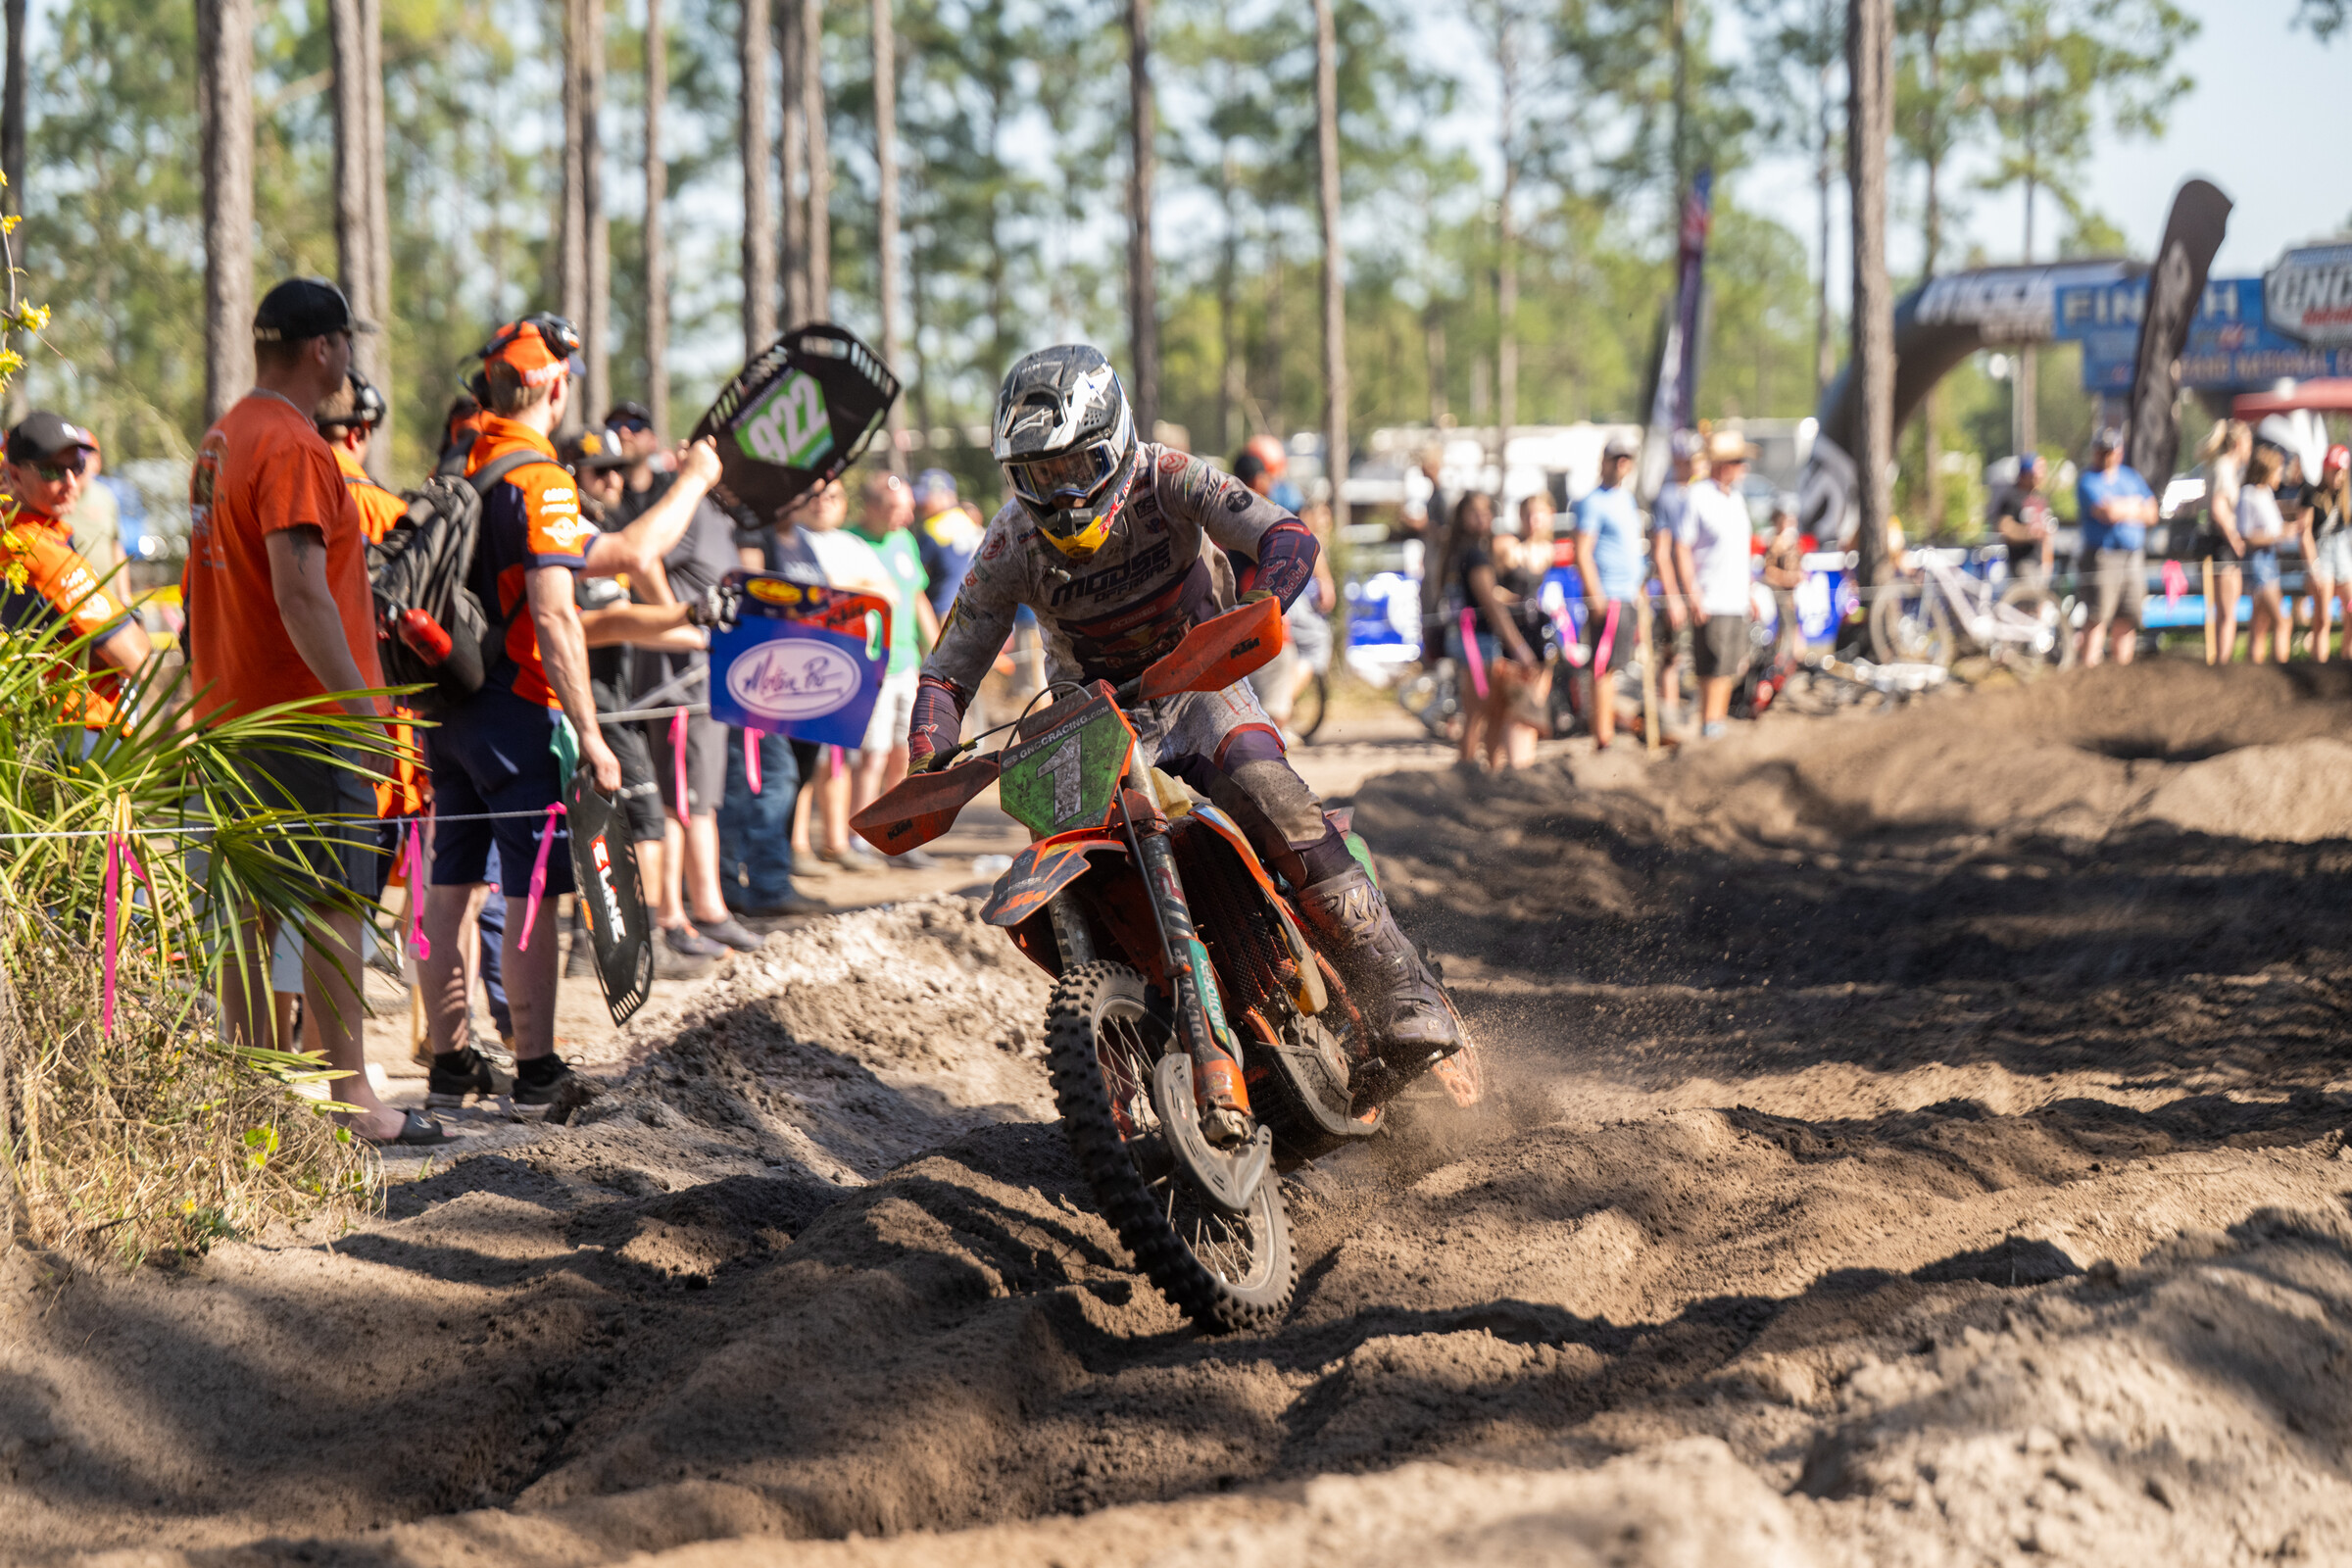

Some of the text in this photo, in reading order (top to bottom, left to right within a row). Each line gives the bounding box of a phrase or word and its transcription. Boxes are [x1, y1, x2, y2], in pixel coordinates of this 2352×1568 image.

[2064, 284, 2238, 324] FINH
[748, 373, 829, 463] 922
[1051, 537, 1170, 607] MOOSE
[1094, 556, 1171, 604] OFFROAD
[742, 649, 845, 697] Motion Pro
[1230, 637, 1260, 660] KTM
[1019, 705, 1110, 760] GNCCRACING.COM
[1036, 730, 1083, 826] 1
[887, 818, 913, 841] KTM
[990, 890, 1048, 920] KTM
[1174, 947, 1204, 1039] DUNLP
[1199, 956, 1226, 1028] MOTOREX
